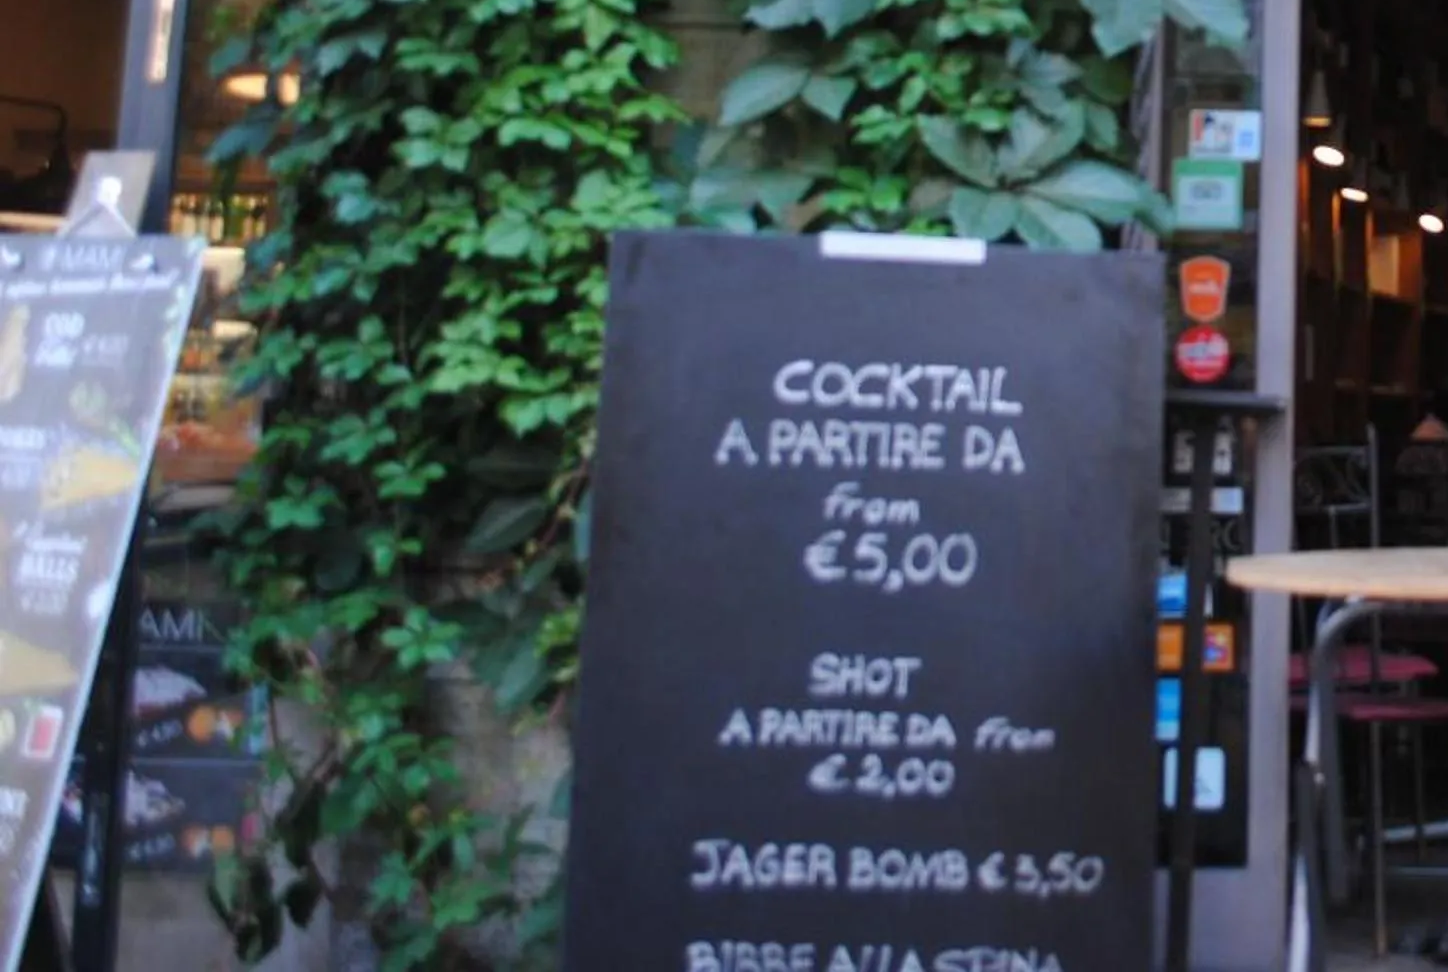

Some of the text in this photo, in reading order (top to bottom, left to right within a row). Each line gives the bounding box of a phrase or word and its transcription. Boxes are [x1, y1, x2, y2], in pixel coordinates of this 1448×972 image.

[773, 359, 1023, 415] COCKTAIL
[713, 418, 1026, 474] A PARTIRE DA
[823, 481, 920, 524] from
[809, 652, 922, 698] SHOT
[719, 707, 752, 748] A
[758, 709, 898, 748] PARTIRE
[905, 714, 957, 748] DA
[690, 839, 837, 890] JAGER
[847, 848, 968, 890] BOMB
